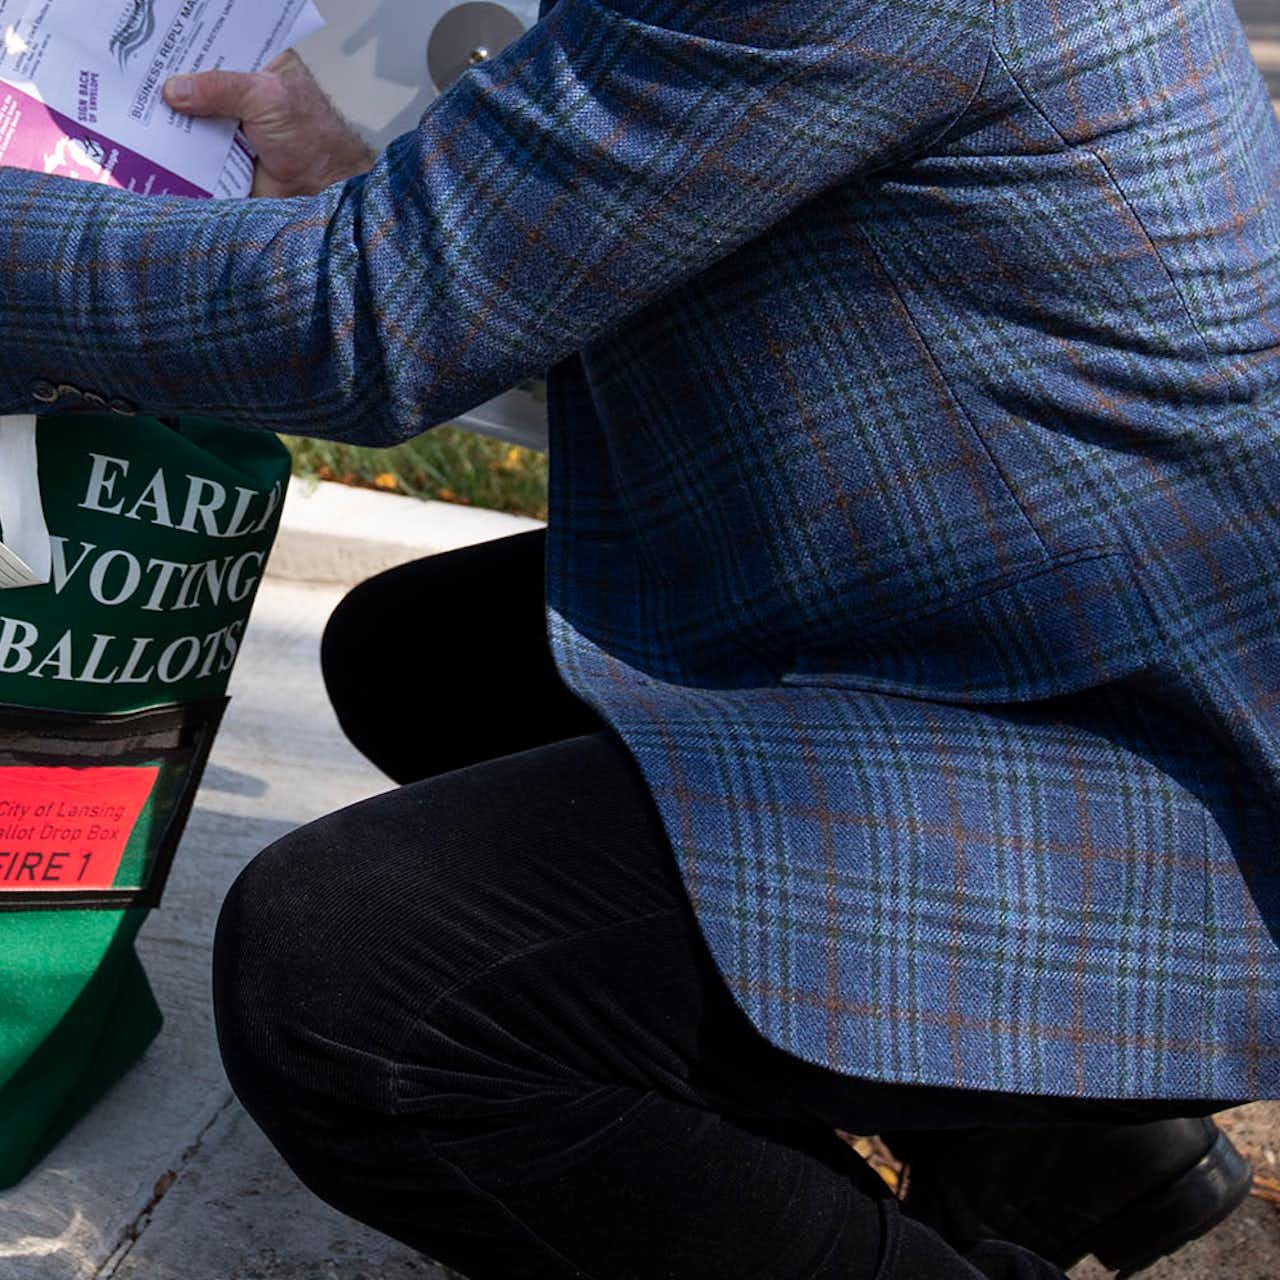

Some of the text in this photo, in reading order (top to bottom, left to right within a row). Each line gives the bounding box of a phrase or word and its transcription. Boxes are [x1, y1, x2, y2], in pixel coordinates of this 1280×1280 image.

[131, 59, 165, 119] BUSINESS
[159, 19, 184, 58] REPLY
[77, 70, 89, 121] SIGN BACK
[49, 535, 265, 611] VOTING
[35, 801, 55, 817] of
[56, 801, 126, 821] Lansing
[39, 824, 82, 844] Drop
[87, 824, 119, 840] Box
[76, 852, 92, 881] 1
